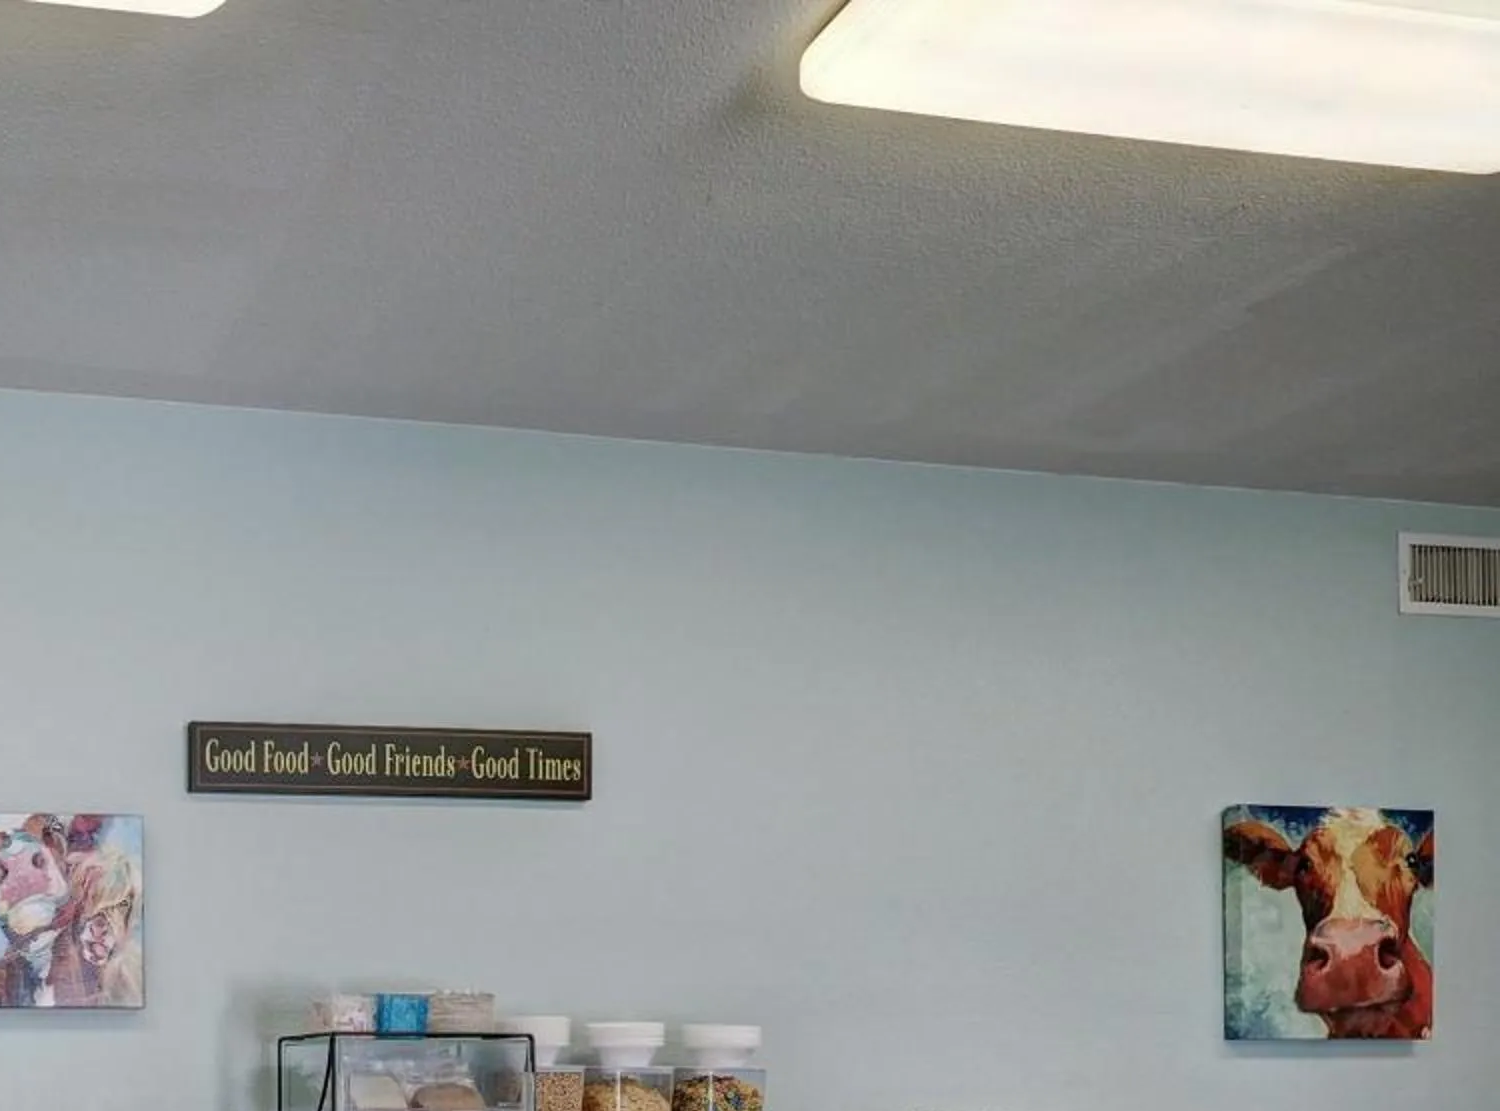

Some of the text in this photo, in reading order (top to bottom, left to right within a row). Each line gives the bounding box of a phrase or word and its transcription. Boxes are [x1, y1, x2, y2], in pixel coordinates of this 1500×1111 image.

[205, 738, 581, 781] Good Food Good Friends Good Times
